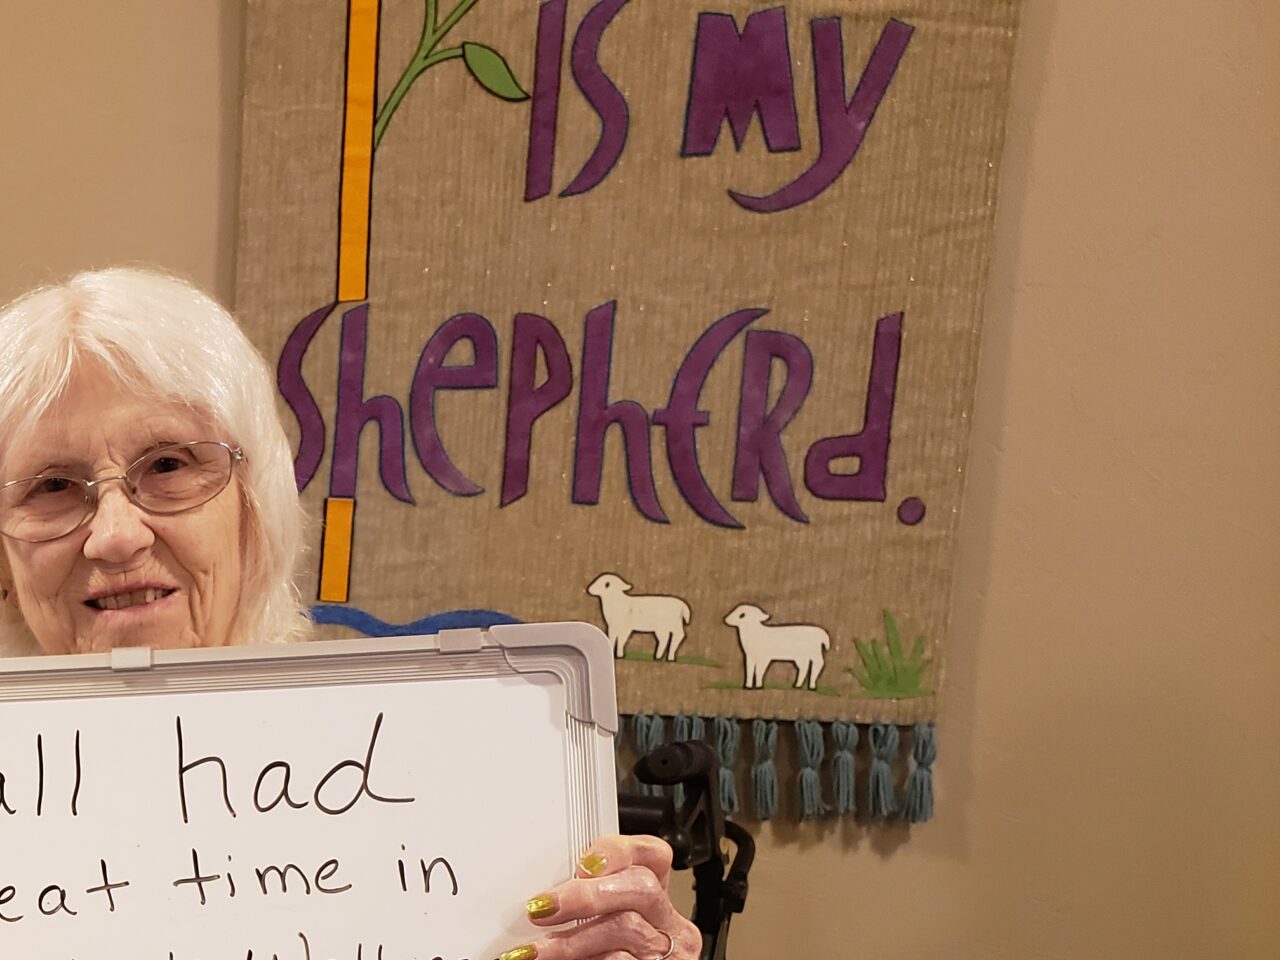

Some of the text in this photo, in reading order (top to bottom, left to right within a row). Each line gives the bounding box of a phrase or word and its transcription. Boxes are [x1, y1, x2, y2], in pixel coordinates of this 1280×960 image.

[176, 712, 415, 824] had
[173, 848, 352, 905] time
[399, 844, 459, 896] in
